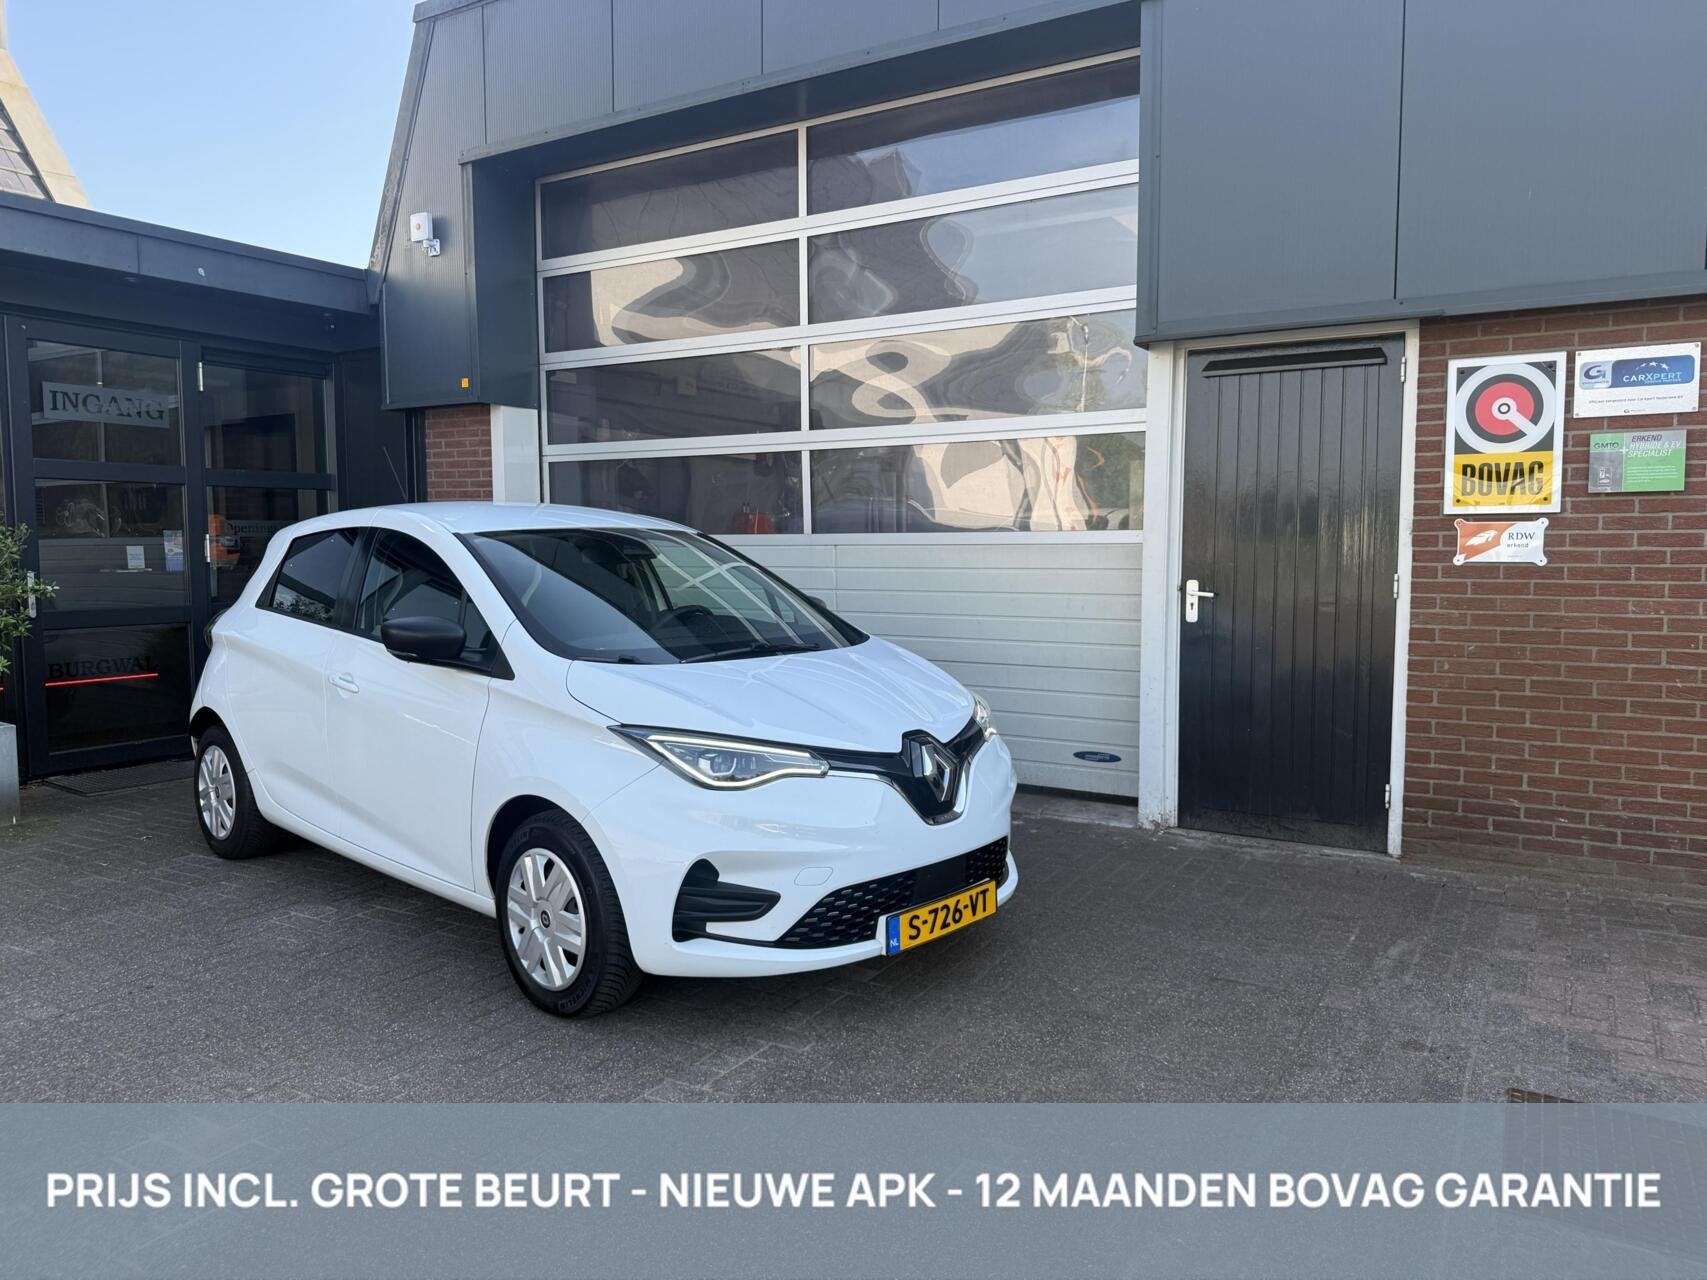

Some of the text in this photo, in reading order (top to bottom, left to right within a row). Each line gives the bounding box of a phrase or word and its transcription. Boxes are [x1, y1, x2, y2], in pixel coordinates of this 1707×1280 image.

[1622, 371, 1682, 383] CARXPERT
[48, 389, 164, 420] INGANG
[1631, 434, 1663, 443] ERKEND
[1629, 441, 1662, 450] HYBRIDE
[1627, 448, 1673, 458] SPECIALIST
[1461, 460, 1544, 497] BOVAG
[1508, 532, 1536, 540] RDW
[48, 655, 160, 680] BURGWAL
[908, 888, 989, 940] S-726-VT
[890, 937, 899, 948] NL
